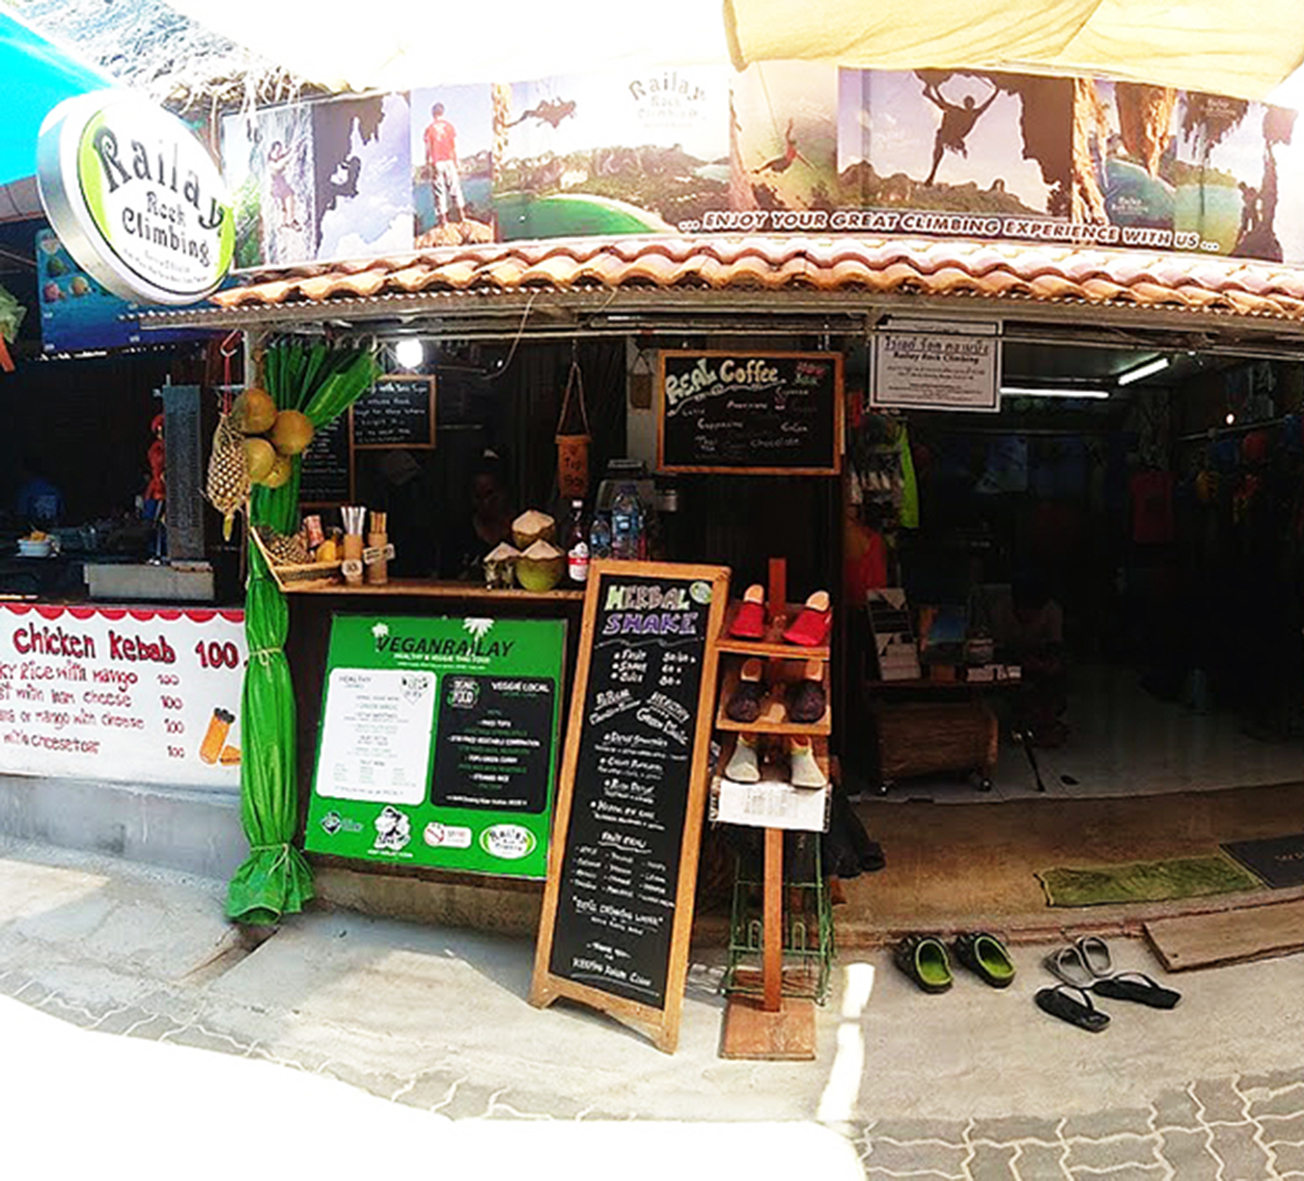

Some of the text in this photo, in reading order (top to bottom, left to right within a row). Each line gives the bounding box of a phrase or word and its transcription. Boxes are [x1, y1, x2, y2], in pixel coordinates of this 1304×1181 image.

[92, 125, 225, 231] Railay
[146, 190, 186, 227] Rock
[121, 206, 210, 268] Climbing
[702, 210, 768, 231] ENJOY
[770, 211, 828, 231] YOUR
[829, 213, 898, 232] GREAT
[901, 214, 1000, 235] CLIMBING
[1003, 218, 1118, 243] EXPERIENCE
[1122, 226, 1173, 247] WITH
[1174, 232, 1200, 249] US
[718, 359, 779, 384] Coffee
[604, 584, 693, 612] HERBAL
[602, 612, 699, 636] SHAKE
[13, 621, 97, 660] Chicken
[108, 629, 176, 664] Kebab
[375, 635, 515, 658] VEGANRAILAY
[20, 660, 55, 681] Rice
[157, 673, 181, 686] 100
[491, 681, 550, 694] VEGGIE LOCAL
[160, 694, 184, 710] 100
[164, 717, 185, 735] 100
[168, 744, 186, 759] 100
